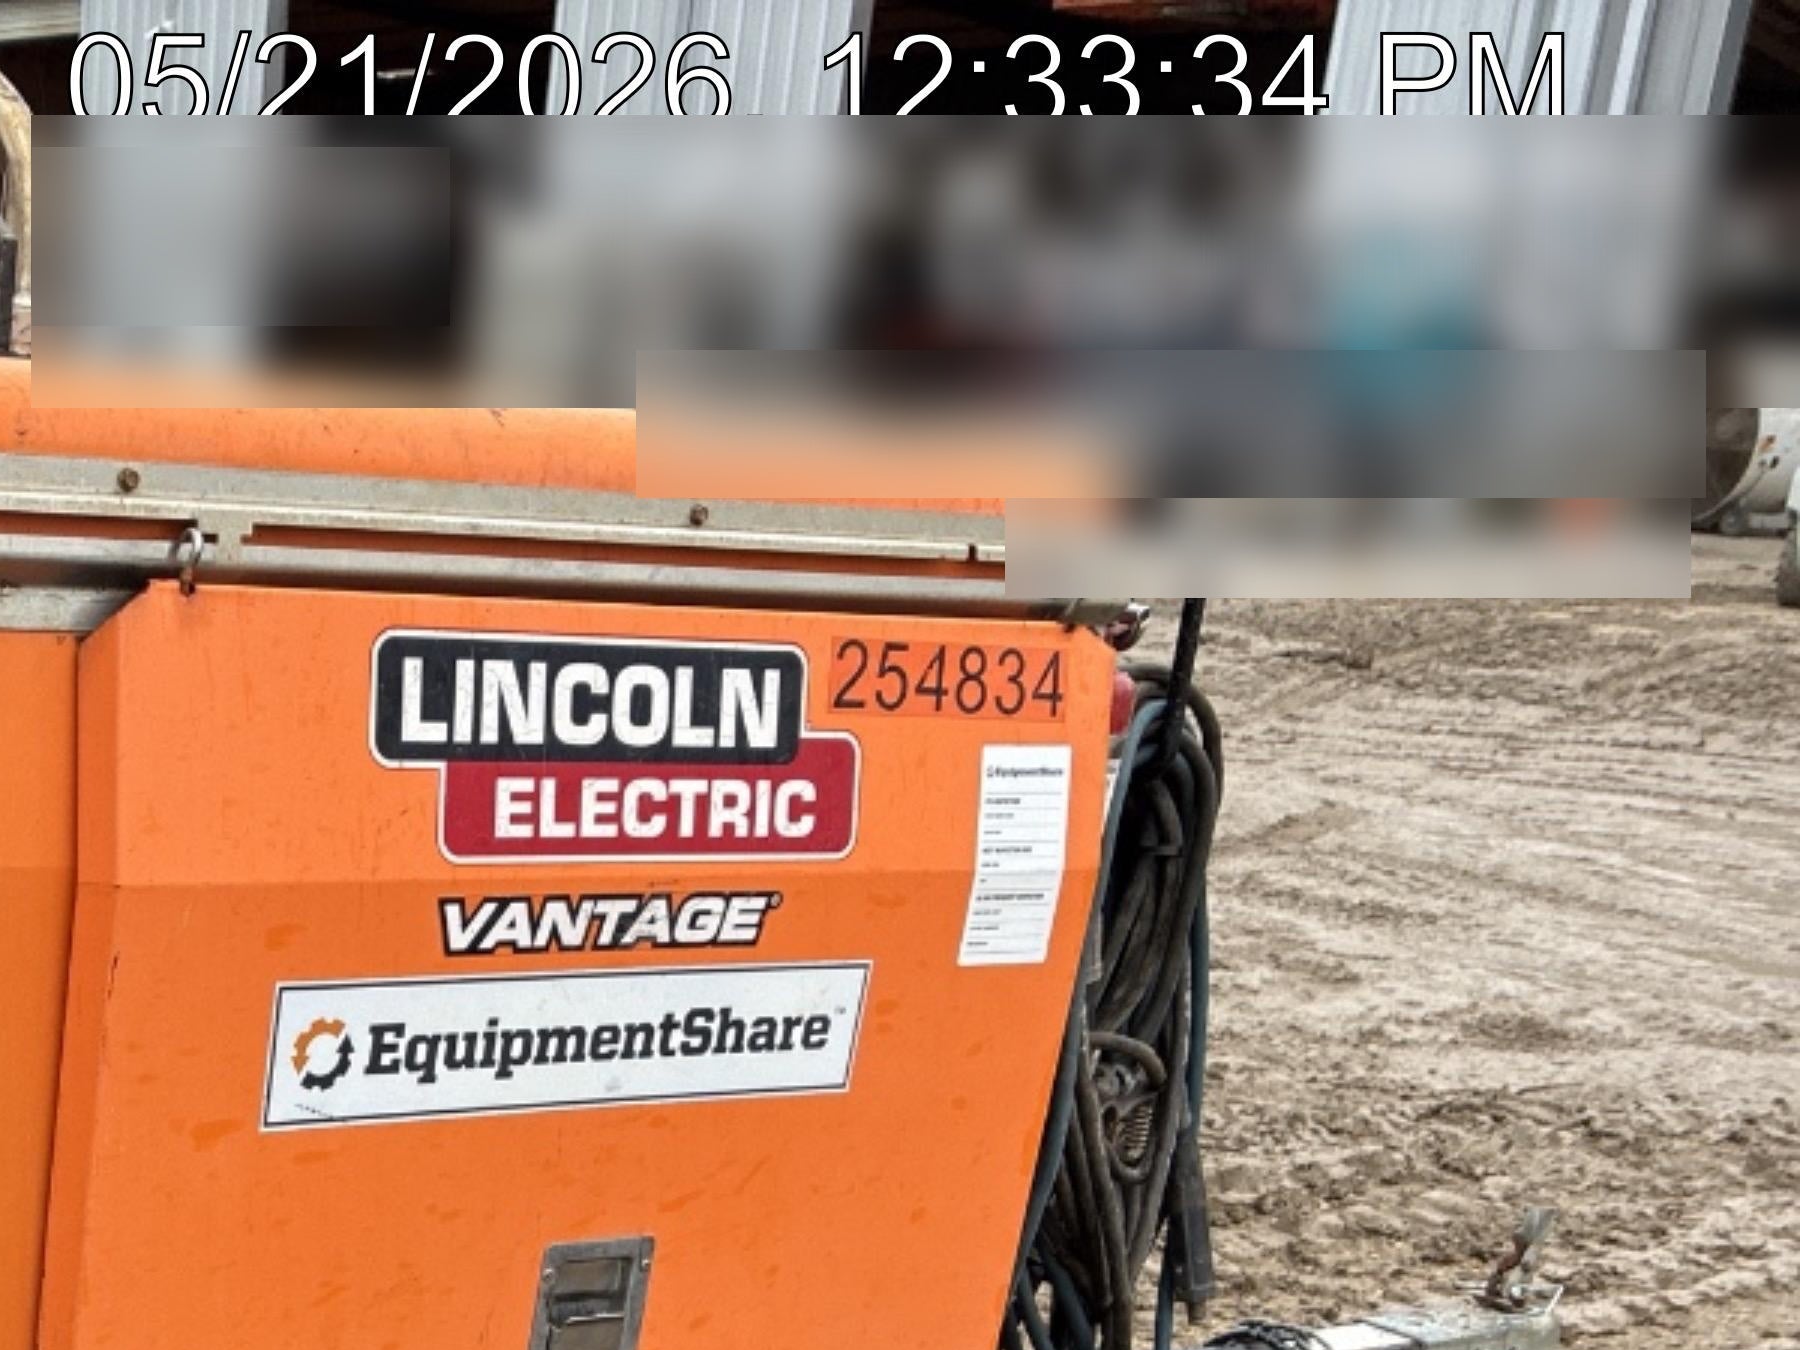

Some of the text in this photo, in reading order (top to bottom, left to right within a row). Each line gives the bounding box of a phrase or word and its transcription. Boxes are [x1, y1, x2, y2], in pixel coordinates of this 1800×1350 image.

[400, 655, 782, 751] LINCOLN
[831, 637, 1067, 720] 254834
[492, 775, 818, 841] ELECTRIC
[442, 894, 772, 953] VANTAGE
[363, 1007, 831, 1084] EquipmentShare
